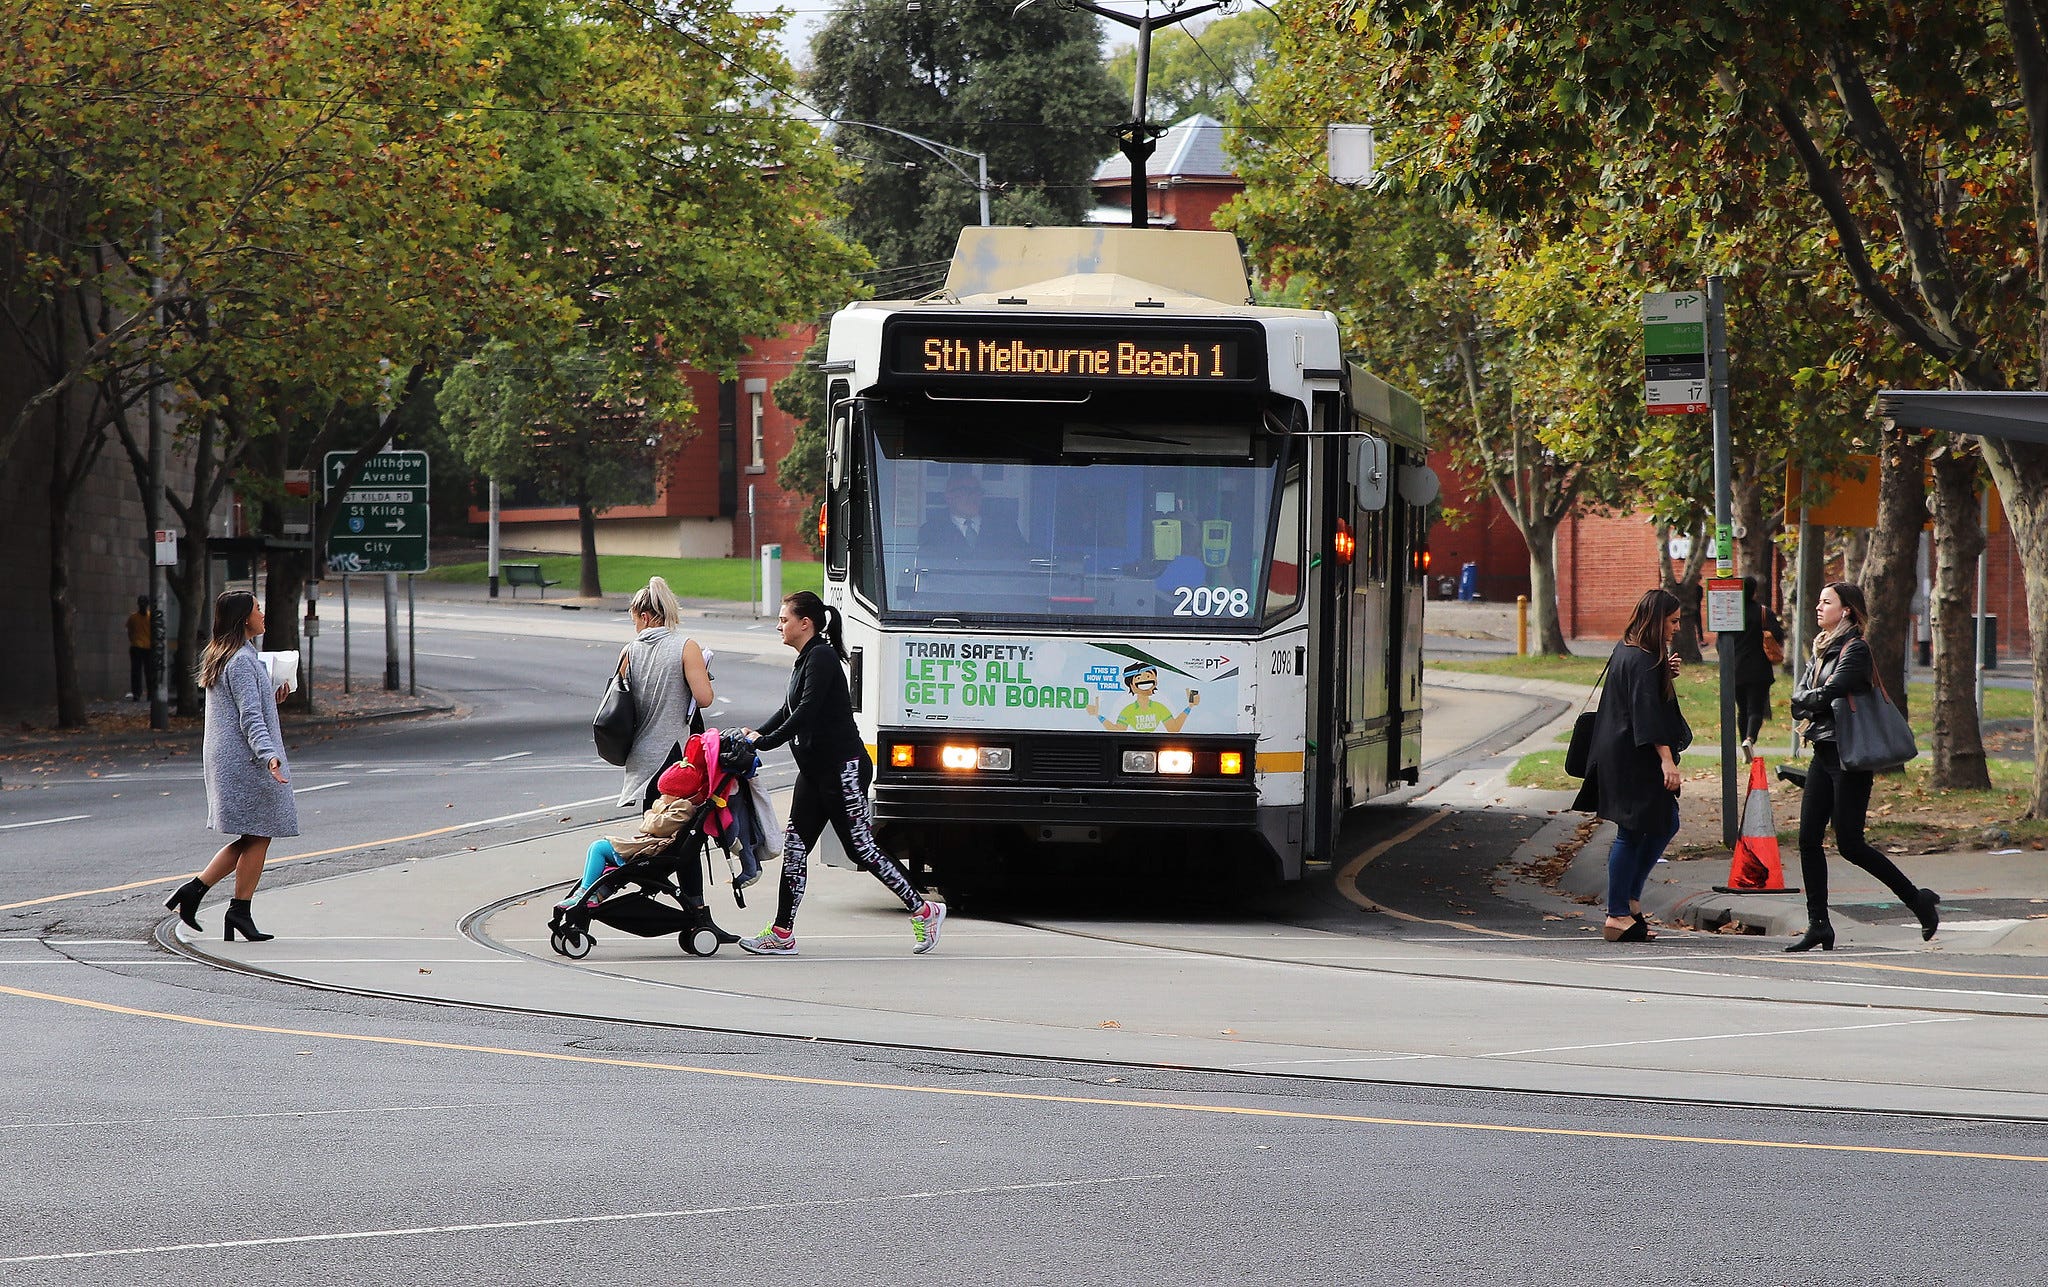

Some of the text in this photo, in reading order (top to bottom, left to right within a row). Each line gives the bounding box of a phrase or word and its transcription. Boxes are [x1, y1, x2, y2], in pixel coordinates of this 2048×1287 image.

[924, 338, 1224, 377] Sth Melbourne Beach 1
[1688, 387, 1703, 400] 17
[365, 459, 421, 471] nlithgow
[363, 471, 411, 482] Avenue
[361, 493, 391, 501] KILDA
[396, 493, 411, 501] RD
[350, 506, 405, 516] St Kilda
[352, 519, 361, 529] 3
[364, 542, 392, 554] City
[1173, 586, 1249, 618] 2098
[905, 642, 1034, 661] TRAM SAFETY:
[1271, 649, 1292, 675] 2098
[905, 658, 1032, 685] LET'S ALL
[1086, 674, 1102, 682] HOW
[1099, 682, 1119, 690] TRAM
[904, 681, 1089, 710] GET ON BOARD
[1135, 714, 1156, 722] TRAM
